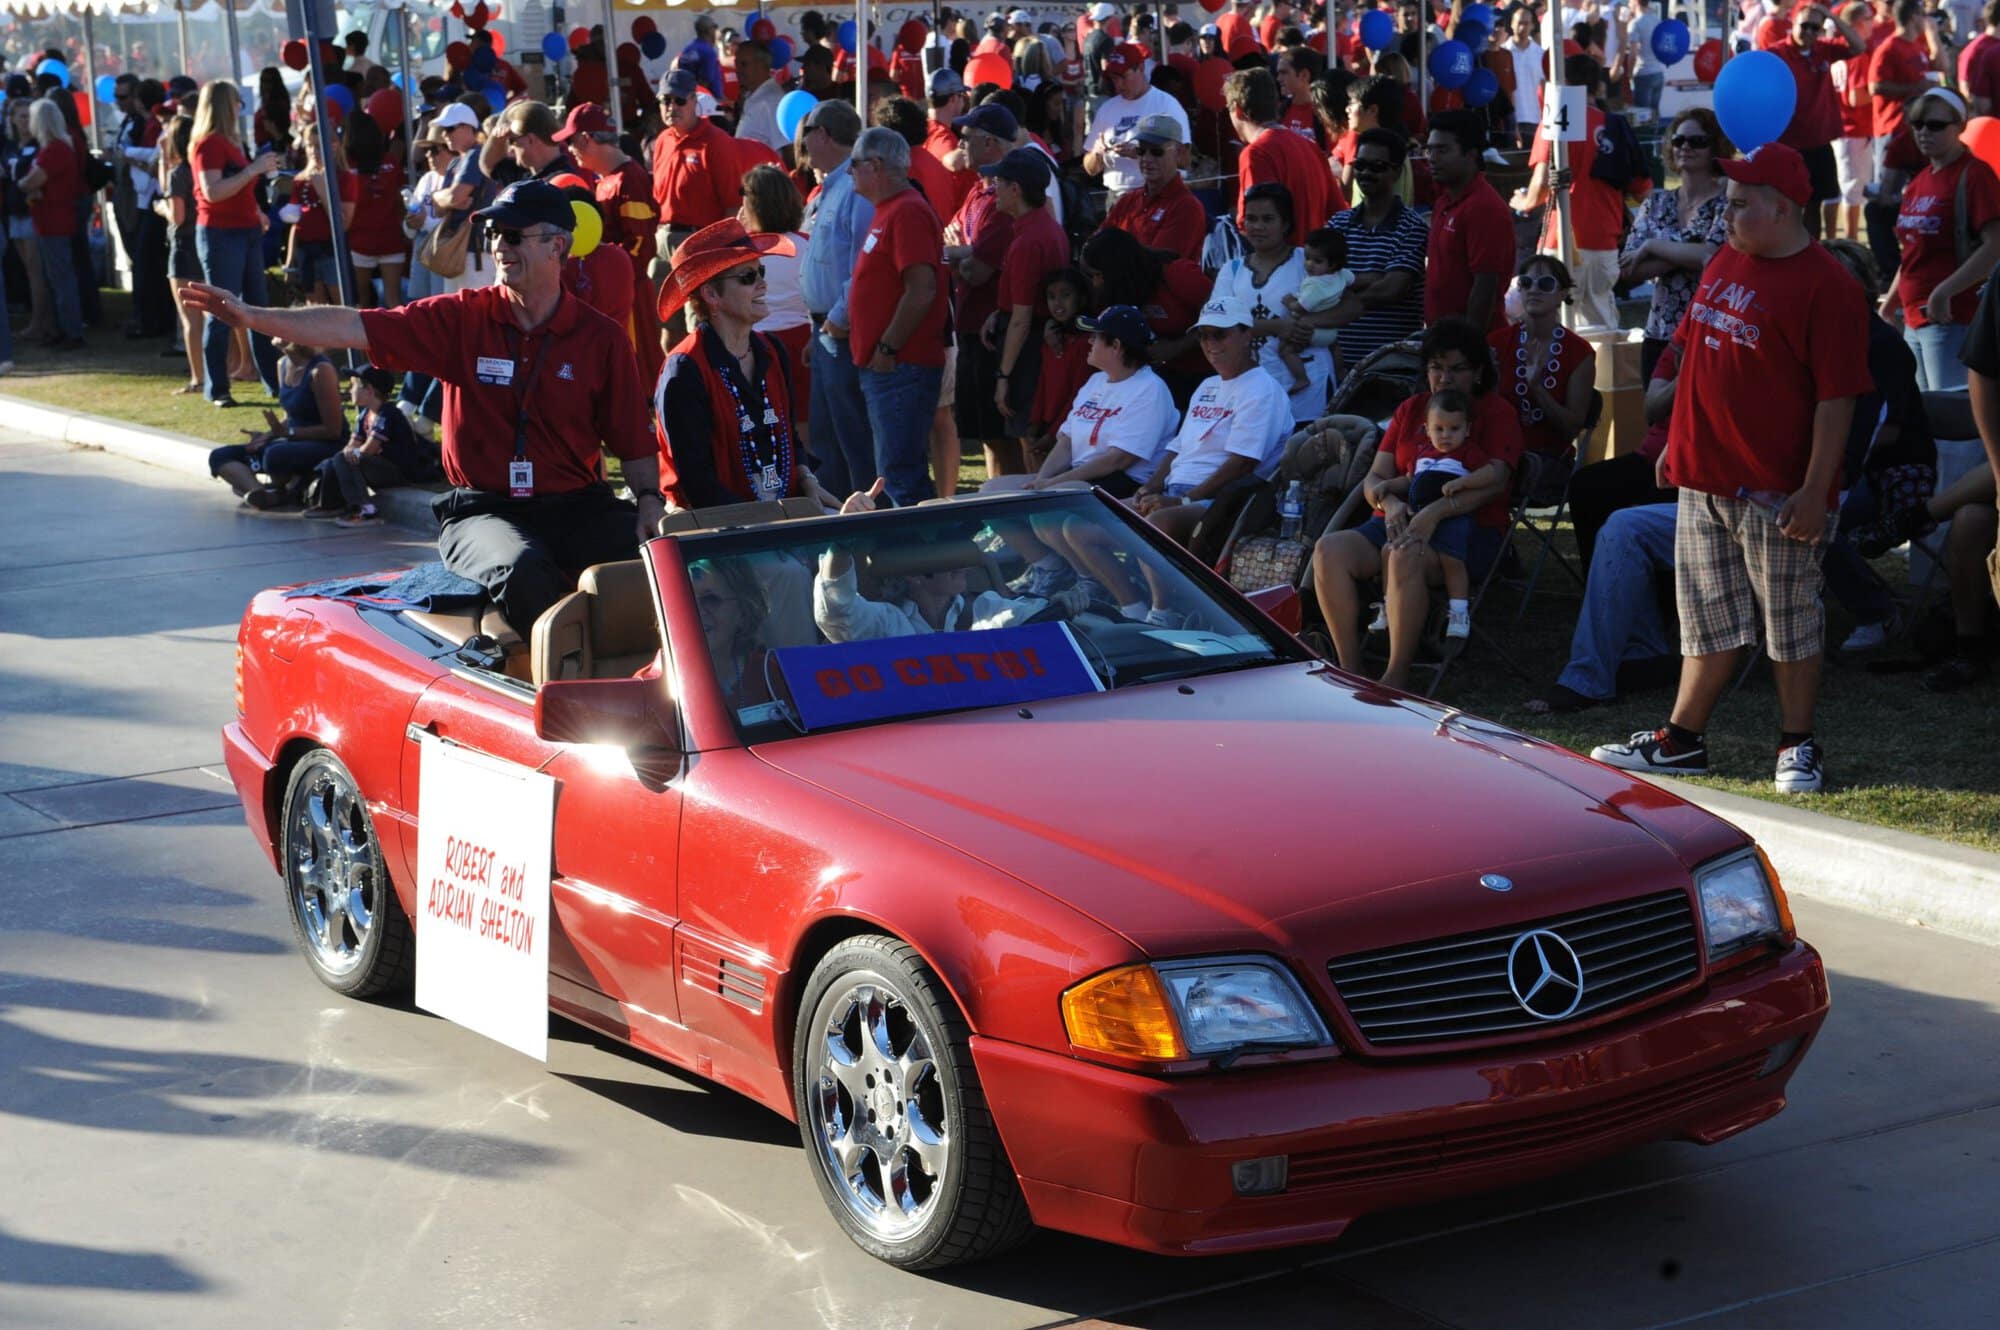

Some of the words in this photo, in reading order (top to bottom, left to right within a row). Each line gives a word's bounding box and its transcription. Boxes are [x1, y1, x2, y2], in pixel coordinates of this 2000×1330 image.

[1713, 282, 1756, 313] AM
[815, 666, 884, 698] GO
[892, 647, 1046, 687] CATS!
[446, 835, 495, 888] ROBERT
[501, 861, 526, 902] and
[428, 878, 475, 931] ADRIAN
[480, 897, 535, 955] SHELTON
